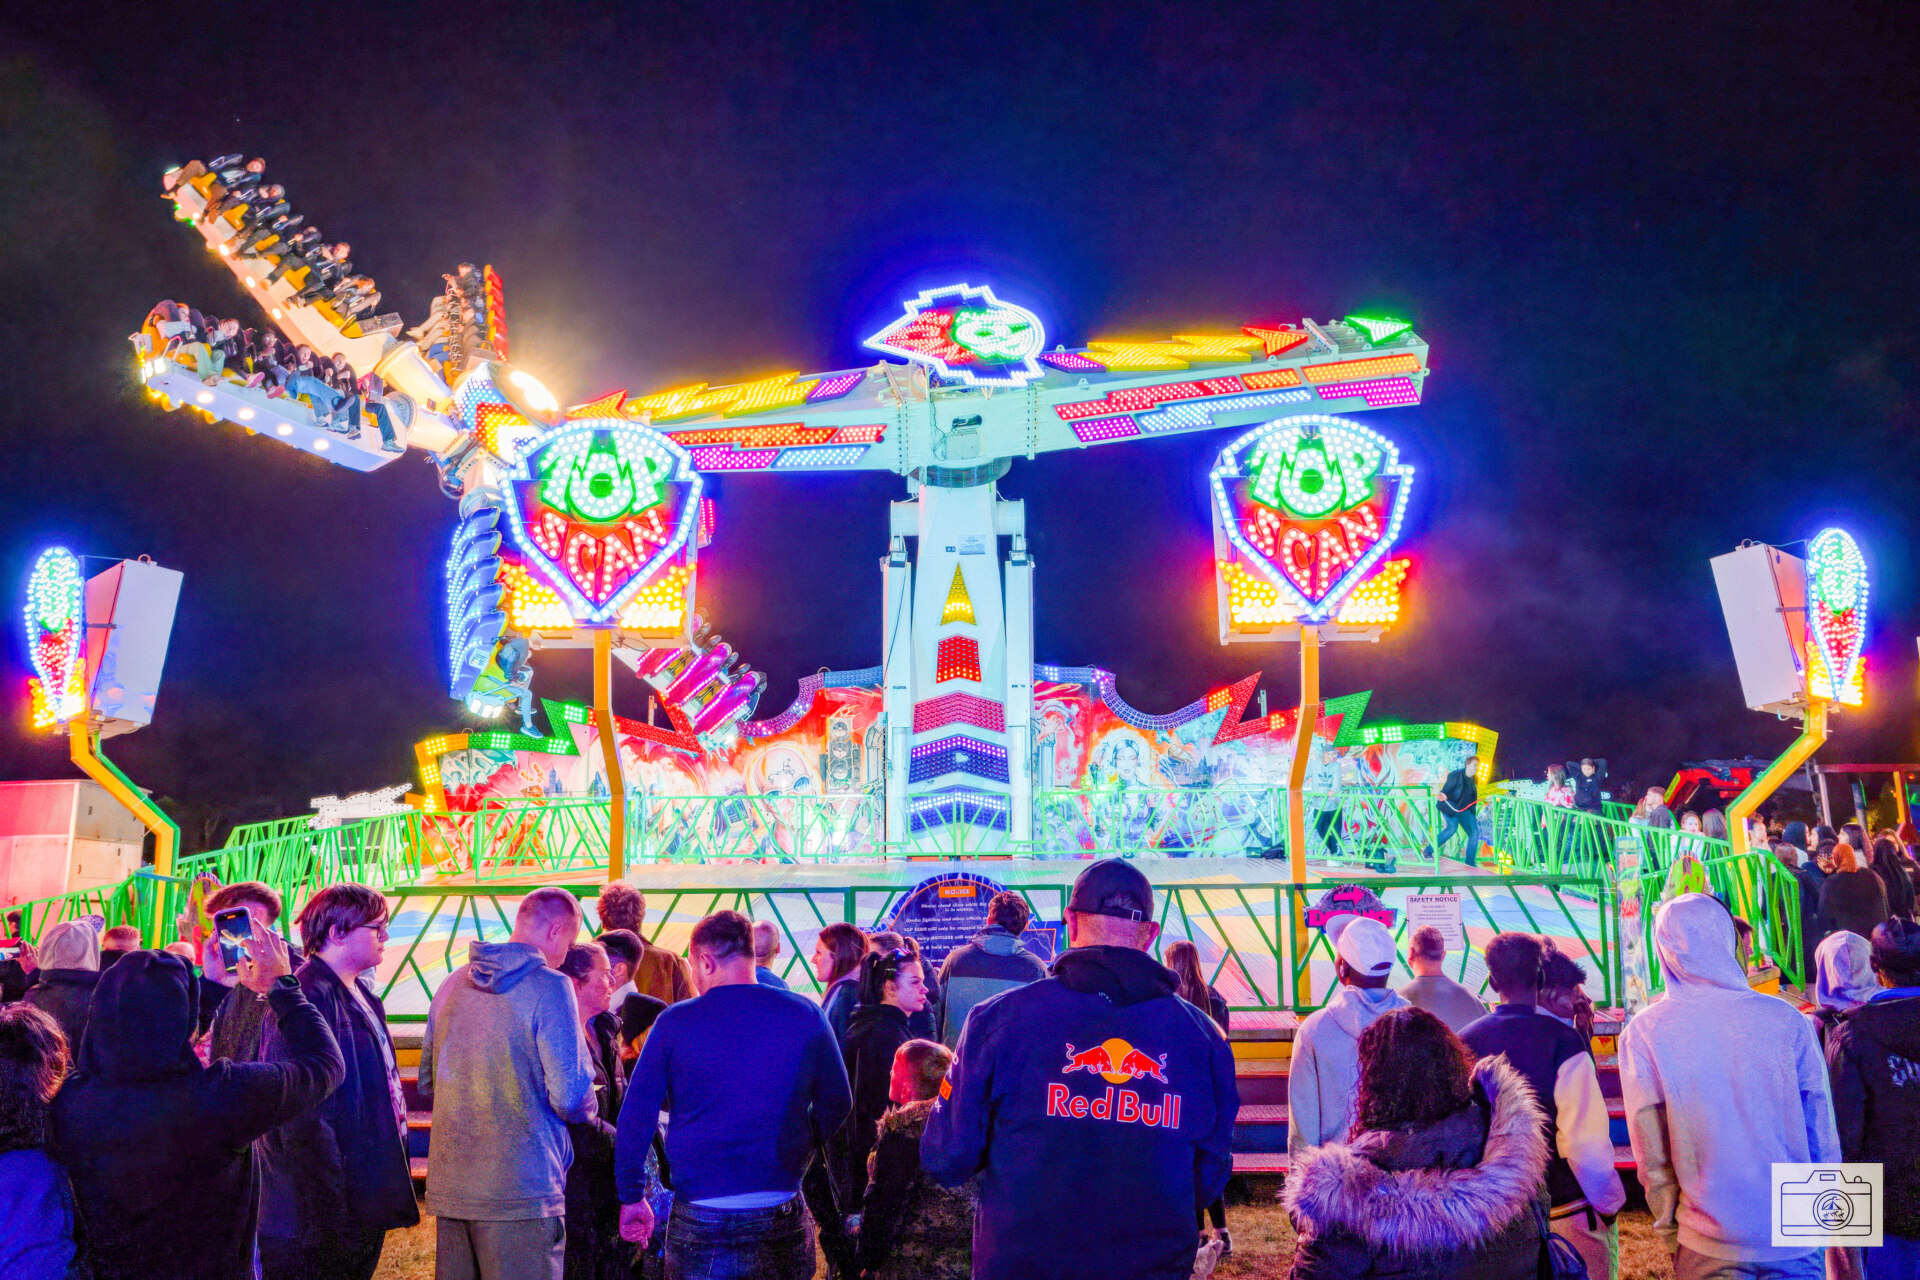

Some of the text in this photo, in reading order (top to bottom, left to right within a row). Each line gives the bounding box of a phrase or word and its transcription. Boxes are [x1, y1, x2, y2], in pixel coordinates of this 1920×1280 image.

[539, 430, 674, 520] TOP
[1248, 425, 1381, 518] TOP
[532, 509, 668, 604] SCAN
[1245, 505, 1379, 602] SCAN
[1046, 1082, 1182, 1130] Red Bull
